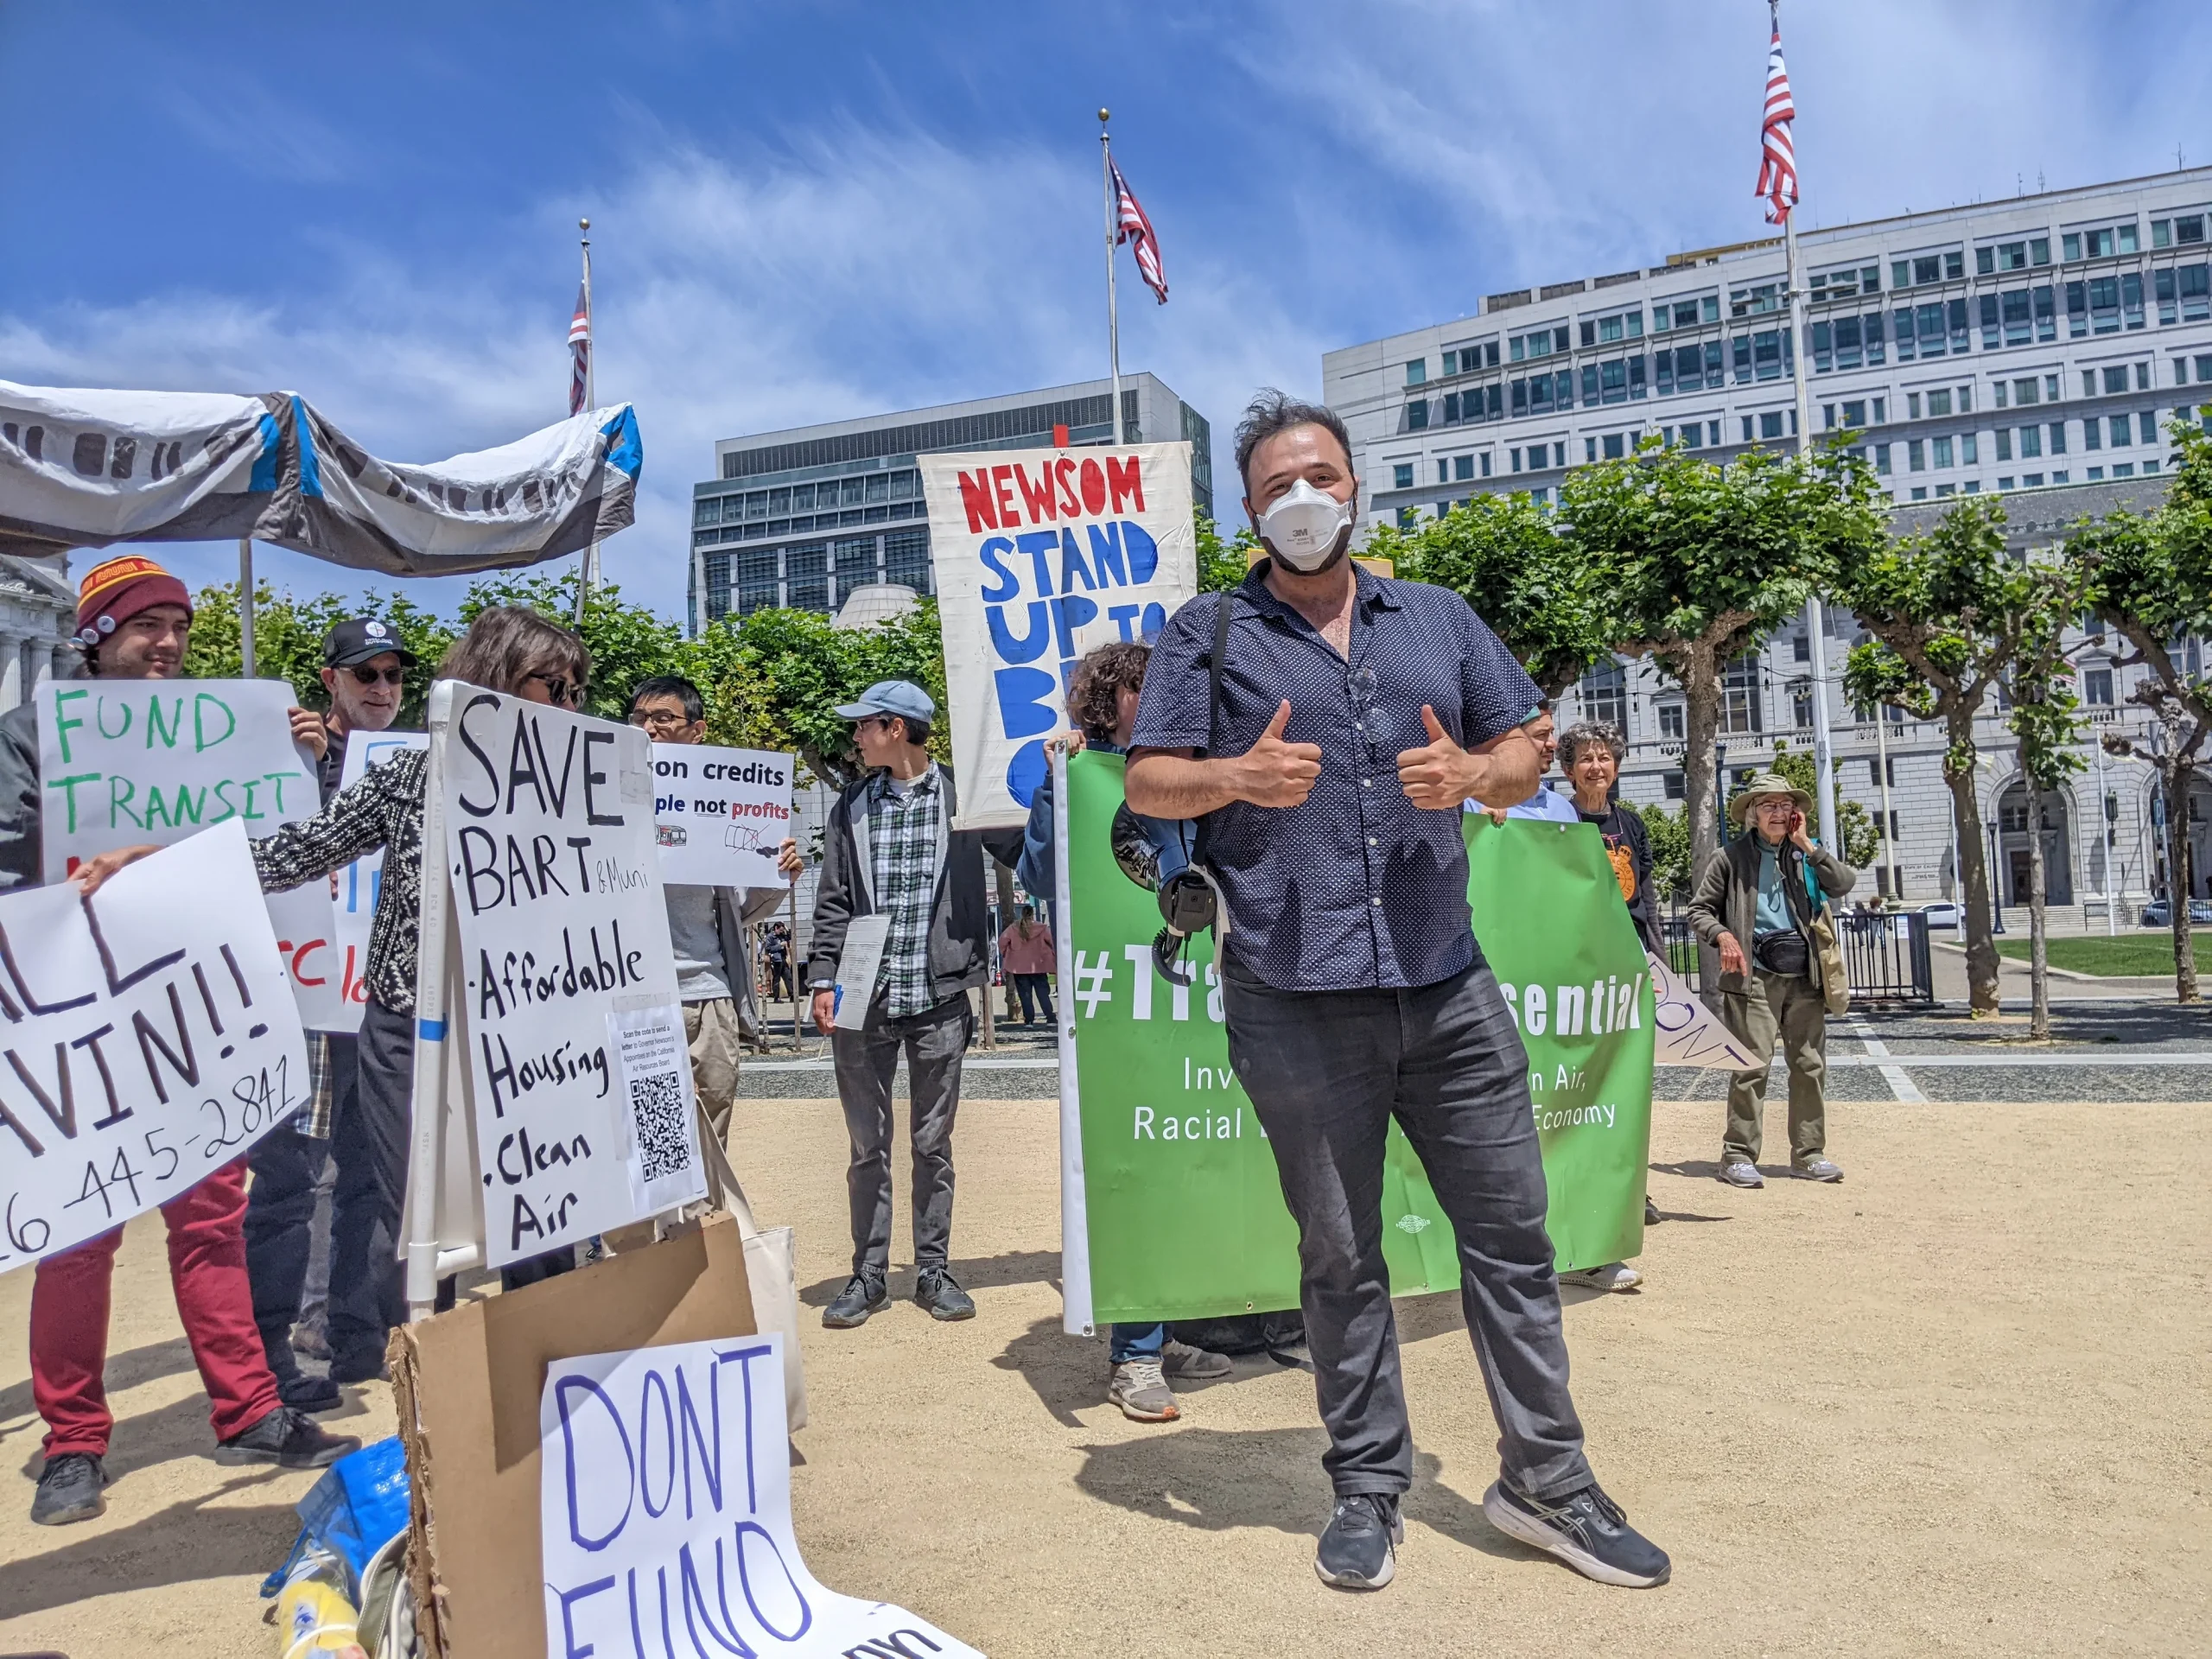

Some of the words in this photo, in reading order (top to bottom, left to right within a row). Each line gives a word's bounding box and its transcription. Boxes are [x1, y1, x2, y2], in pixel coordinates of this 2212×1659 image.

[957, 455, 1146, 534] NEWSOM
[979, 520, 1159, 603] STAND
[1293, 528, 1308, 537] 3M
[985, 594, 1098, 665] UP
[55, 689, 236, 764] FUND
[458, 694, 626, 827] SAVE
[47, 772, 302, 835] TRANSIT
[694, 797, 728, 815] not
[731, 801, 789, 820] profits
[702, 761, 785, 787] credits
[458, 825, 592, 917] BART
[480, 918, 645, 1020] Affordable
[480, 1032, 611, 1118] Housing
[1554, 1064, 1586, 1092] Air,
[497, 1126, 592, 1186] Clean
[1134, 1106, 1242, 1140] Racial
[1532, 1103, 1616, 1131] Economy
[511, 1192, 579, 1251] Air
[555, 1344, 772, 1552] DONT
